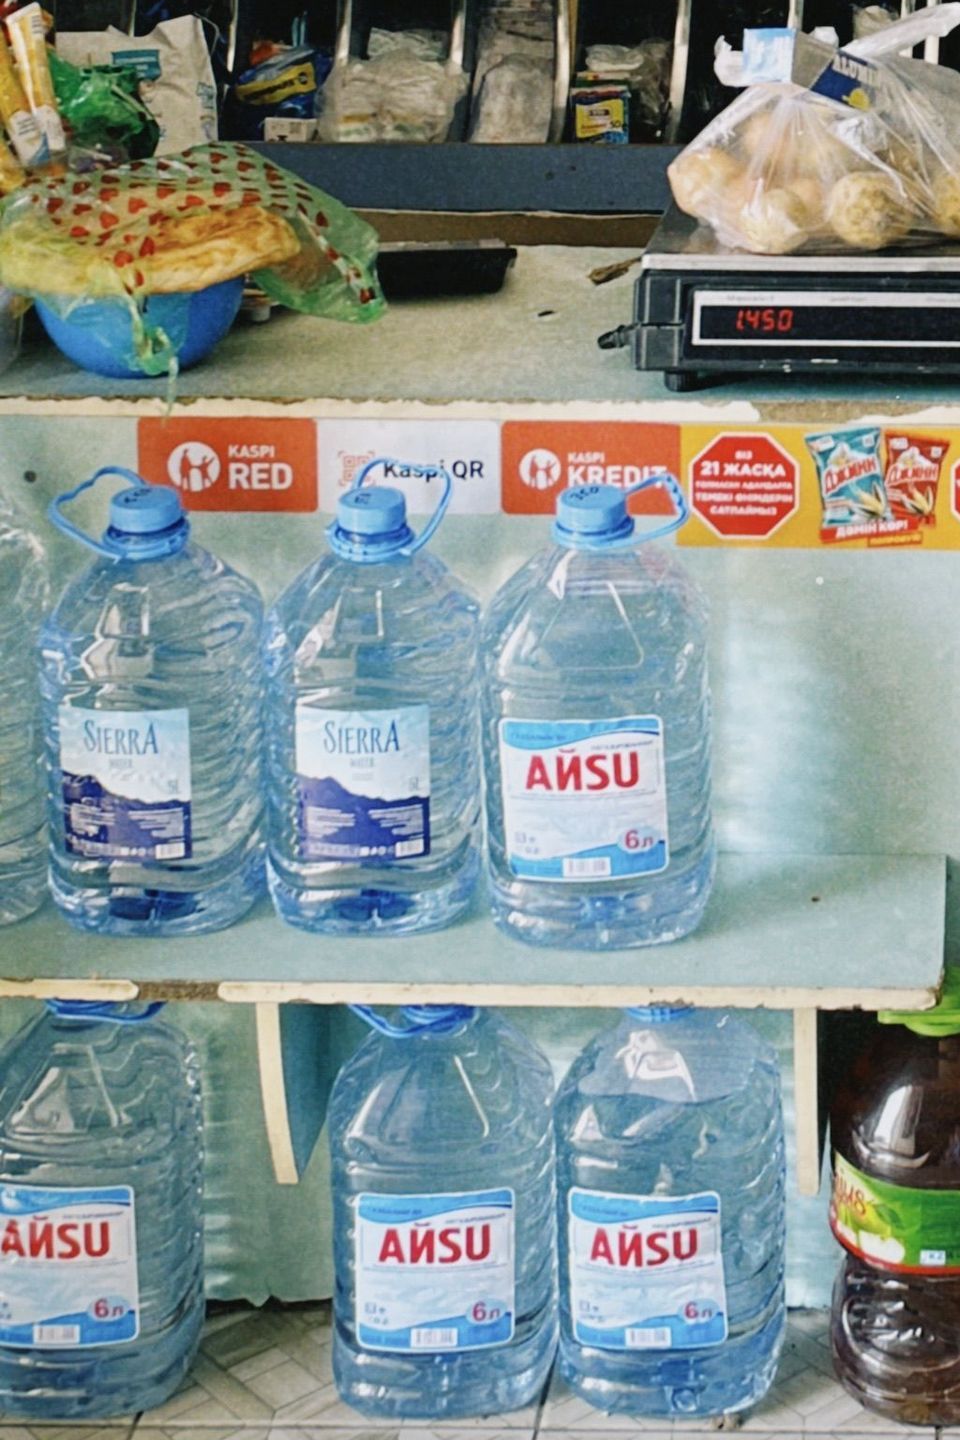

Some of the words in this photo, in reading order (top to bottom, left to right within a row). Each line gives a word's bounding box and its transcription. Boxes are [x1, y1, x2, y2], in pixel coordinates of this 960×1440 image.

[736, 308, 794, 331] 1450
[228, 444, 276, 459] KASPI
[568, 451, 605, 463] KASPI
[229, 462, 293, 491] RED
[383, 459, 445, 481] Kaspi
[453, 459, 485, 482] QR
[568, 466, 668, 491] KREDIT
[700, 462, 720, 476] 21
[723, 463, 787, 479] ЖАСҚА
[823, 458, 877, 493] ДЖИНН
[887, 462, 938, 483] ДЖИНН
[83, 720, 159, 755] SIERRA
[323, 720, 401, 755] SIERRA
